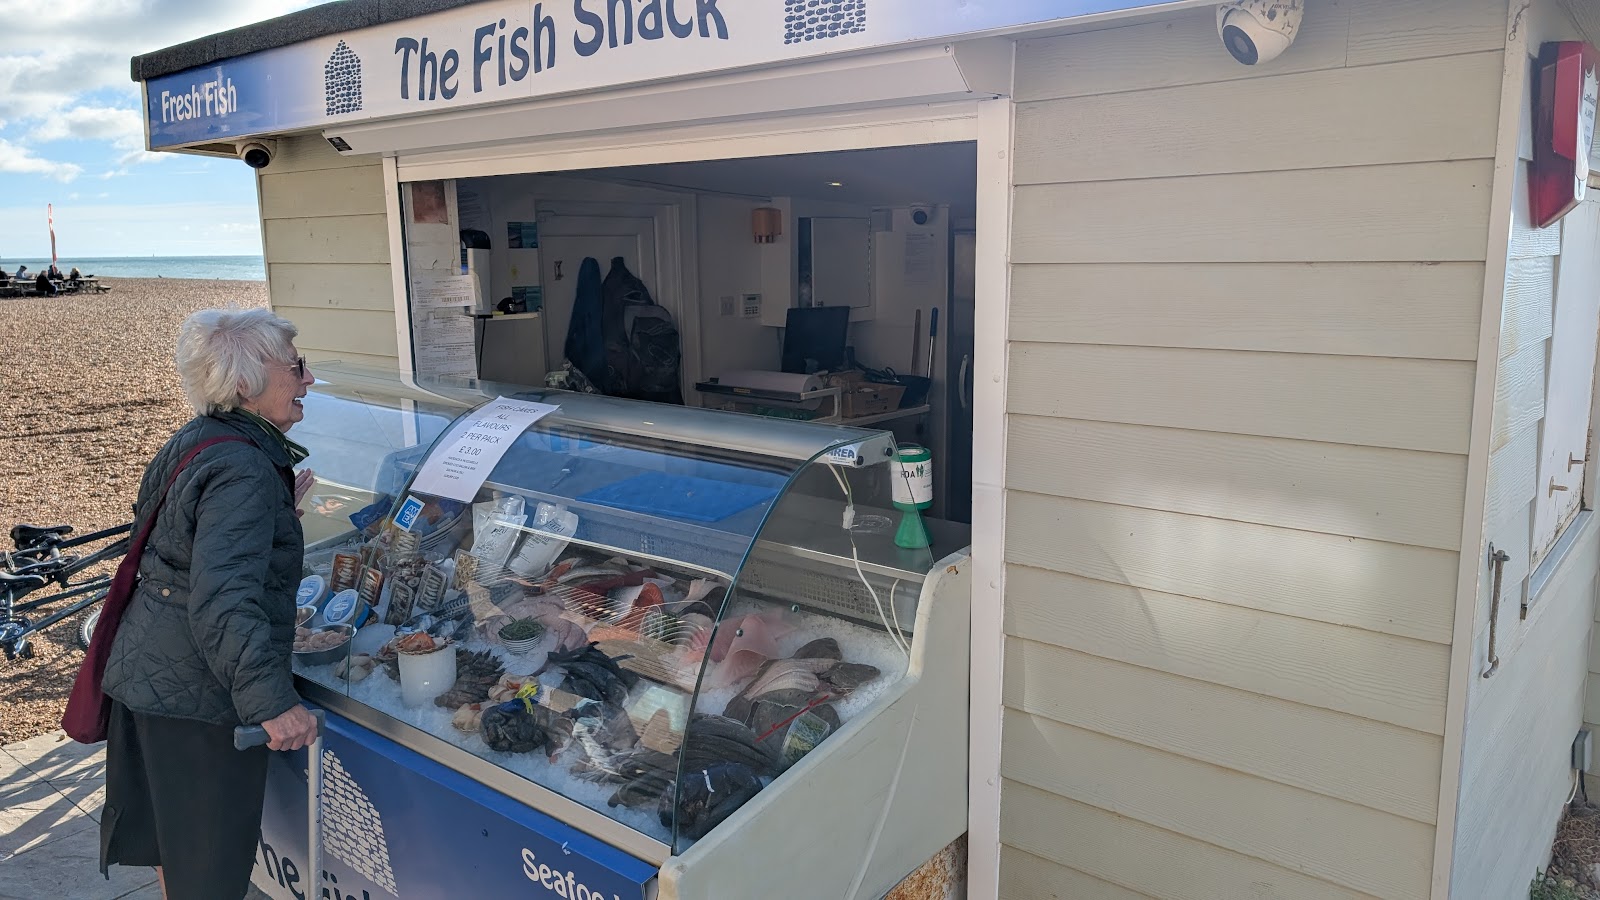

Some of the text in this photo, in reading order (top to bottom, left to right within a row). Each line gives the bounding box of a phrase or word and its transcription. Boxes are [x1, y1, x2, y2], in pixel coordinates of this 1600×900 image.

[394, 37, 460, 101] The
[473, 2, 557, 93] Fish
[161, 78, 237, 123] Fresh Fish
[473, 421, 512, 432] FLAVOURS
[460, 431, 502, 445] 2 PER PACK
[404, 505, 419, 517] AM
[402, 513, 415, 526] EX
[257, 837, 305, 900] he
